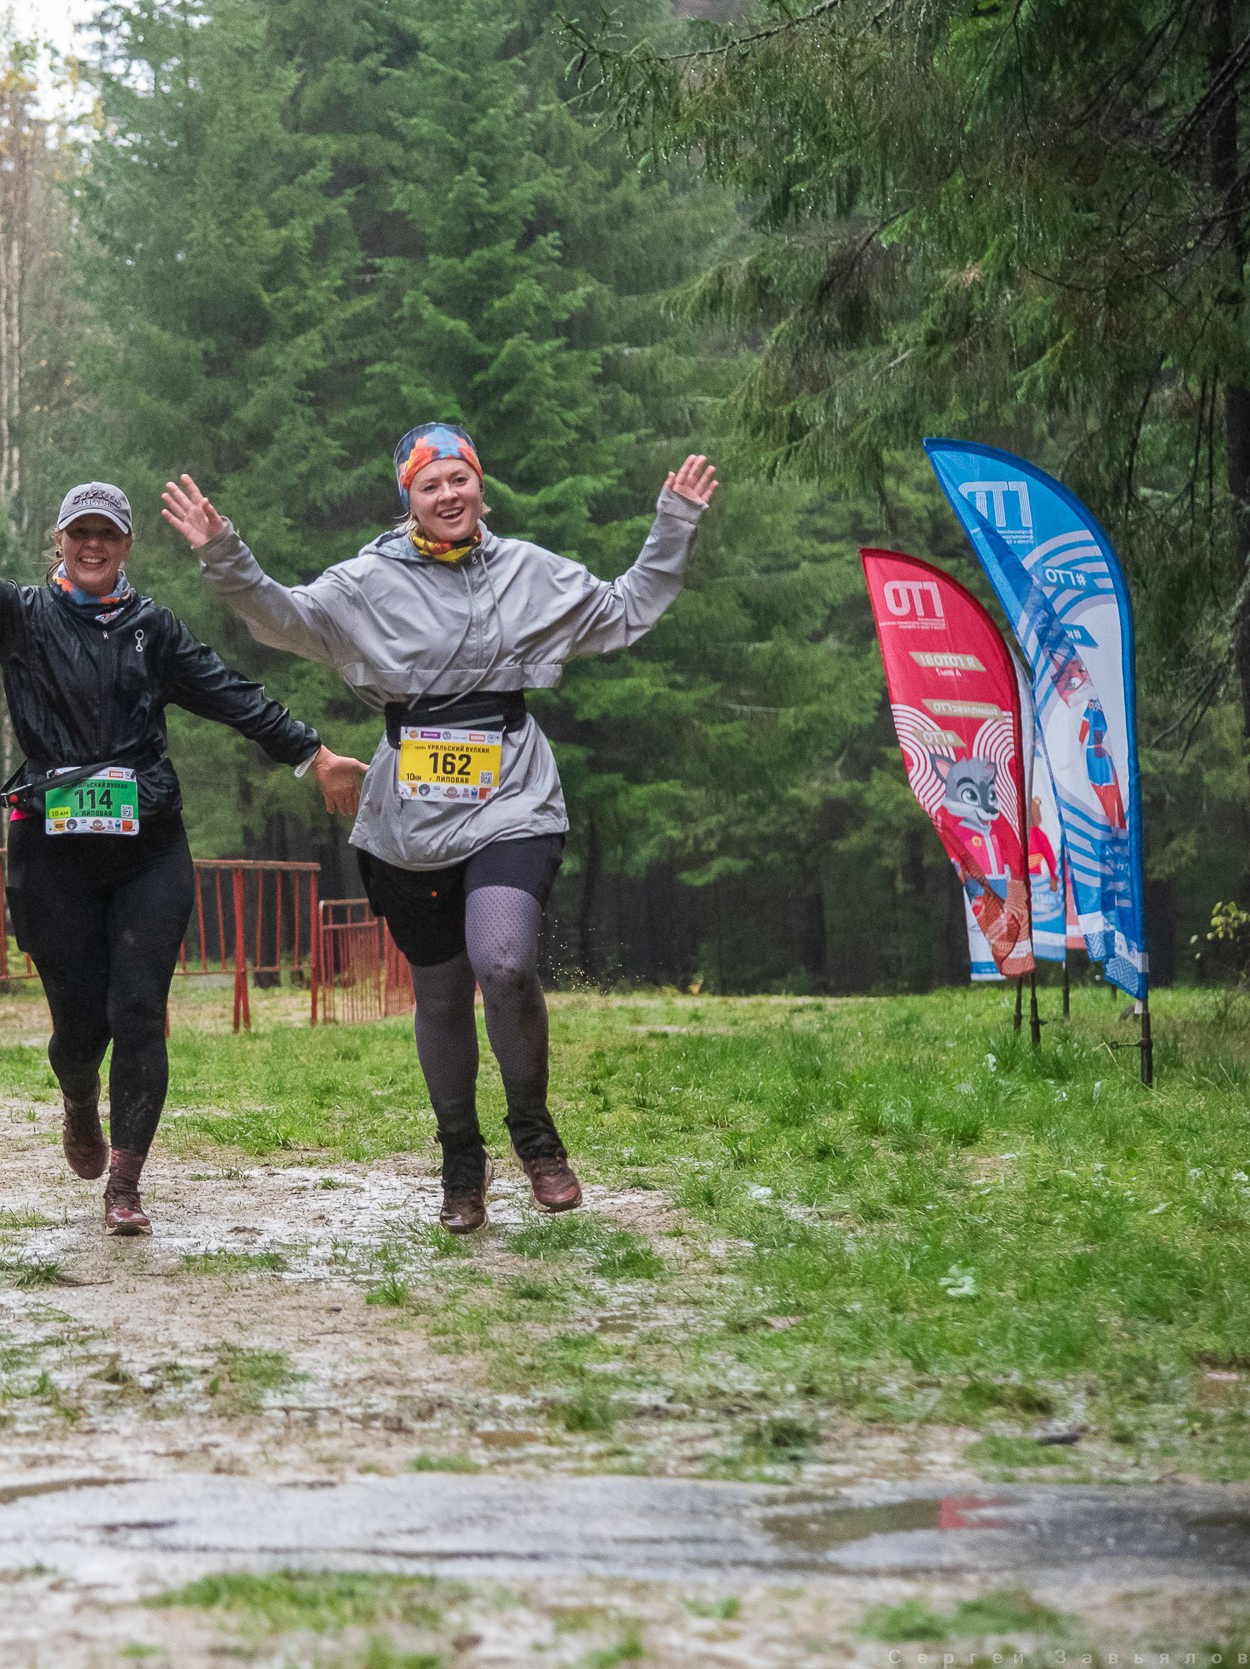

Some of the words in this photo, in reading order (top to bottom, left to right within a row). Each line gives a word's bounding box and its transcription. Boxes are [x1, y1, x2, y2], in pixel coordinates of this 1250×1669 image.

[427, 744, 465, 752] УРАЛЬСКИЙ
[466, 746, 490, 754] ВУЛКАН
[429, 751, 472, 776] 162
[435, 775, 469, 784] ЛИПОВАЯ
[74, 789, 114, 810] 114
